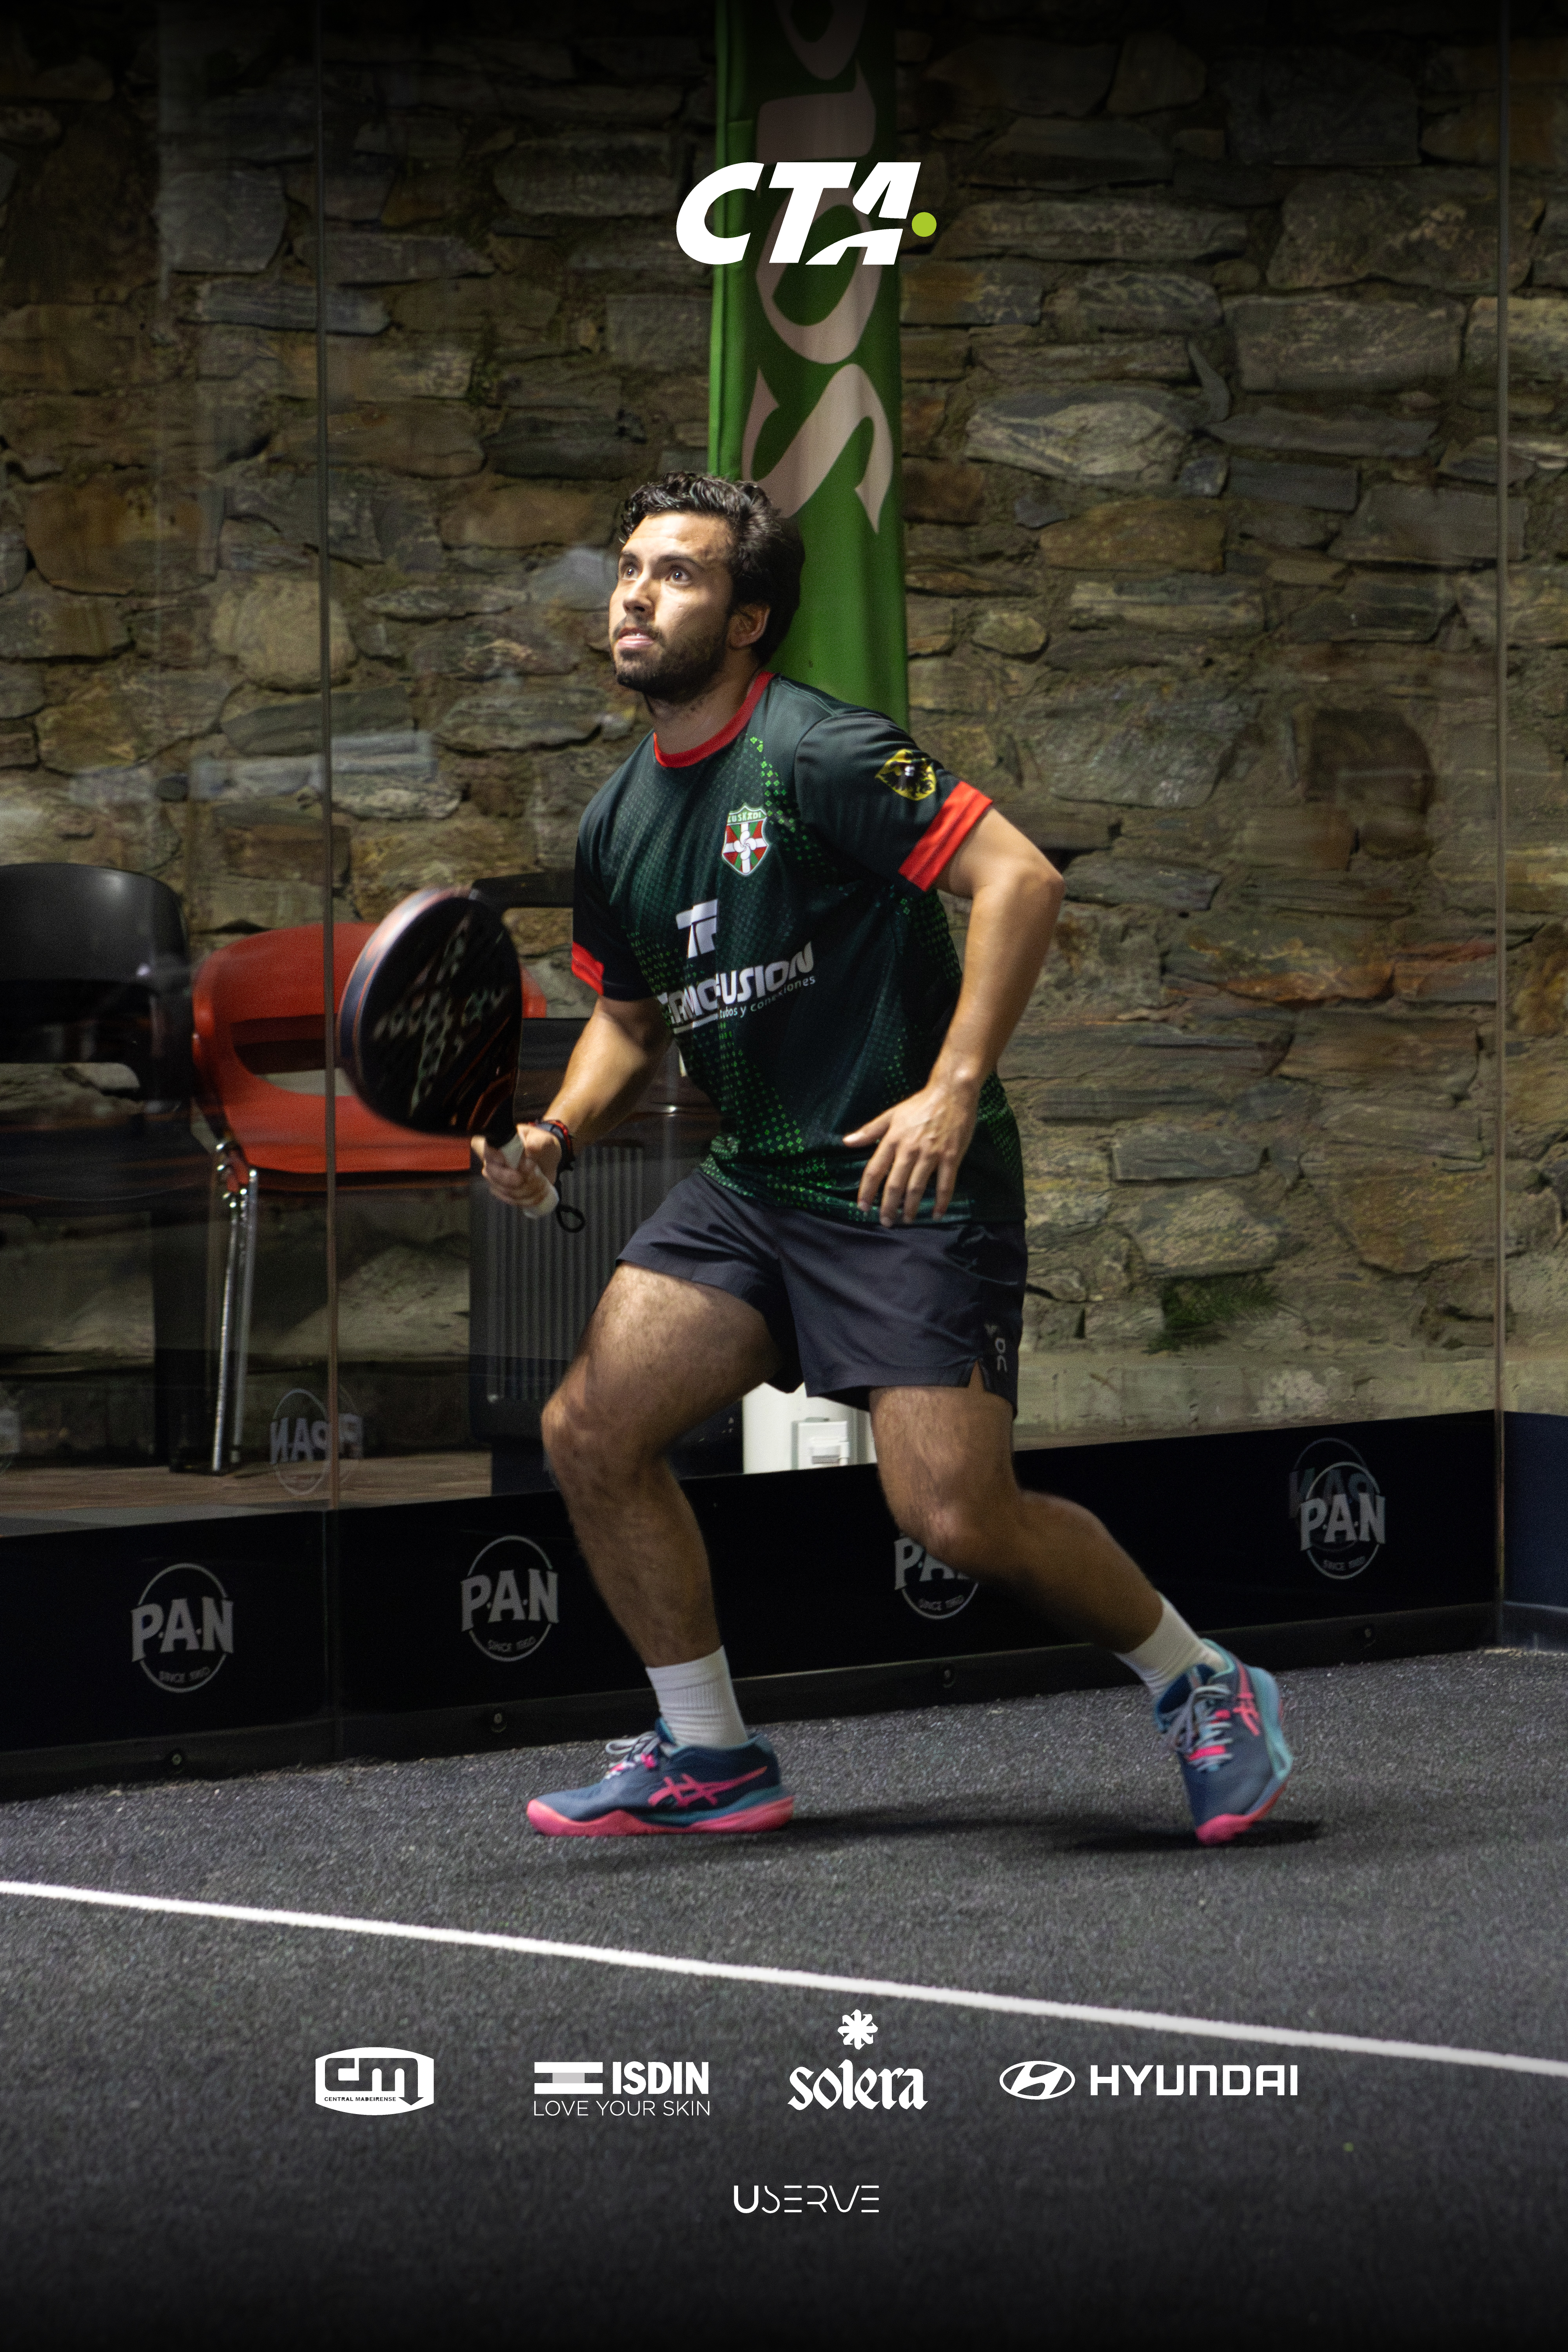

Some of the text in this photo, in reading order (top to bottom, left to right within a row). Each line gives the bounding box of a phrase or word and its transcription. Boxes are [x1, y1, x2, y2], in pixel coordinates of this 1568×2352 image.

[727, 811, 761, 823] EUSKADI
[720, 1005, 738, 1019] tubos
[740, 1005, 747, 1018] y
